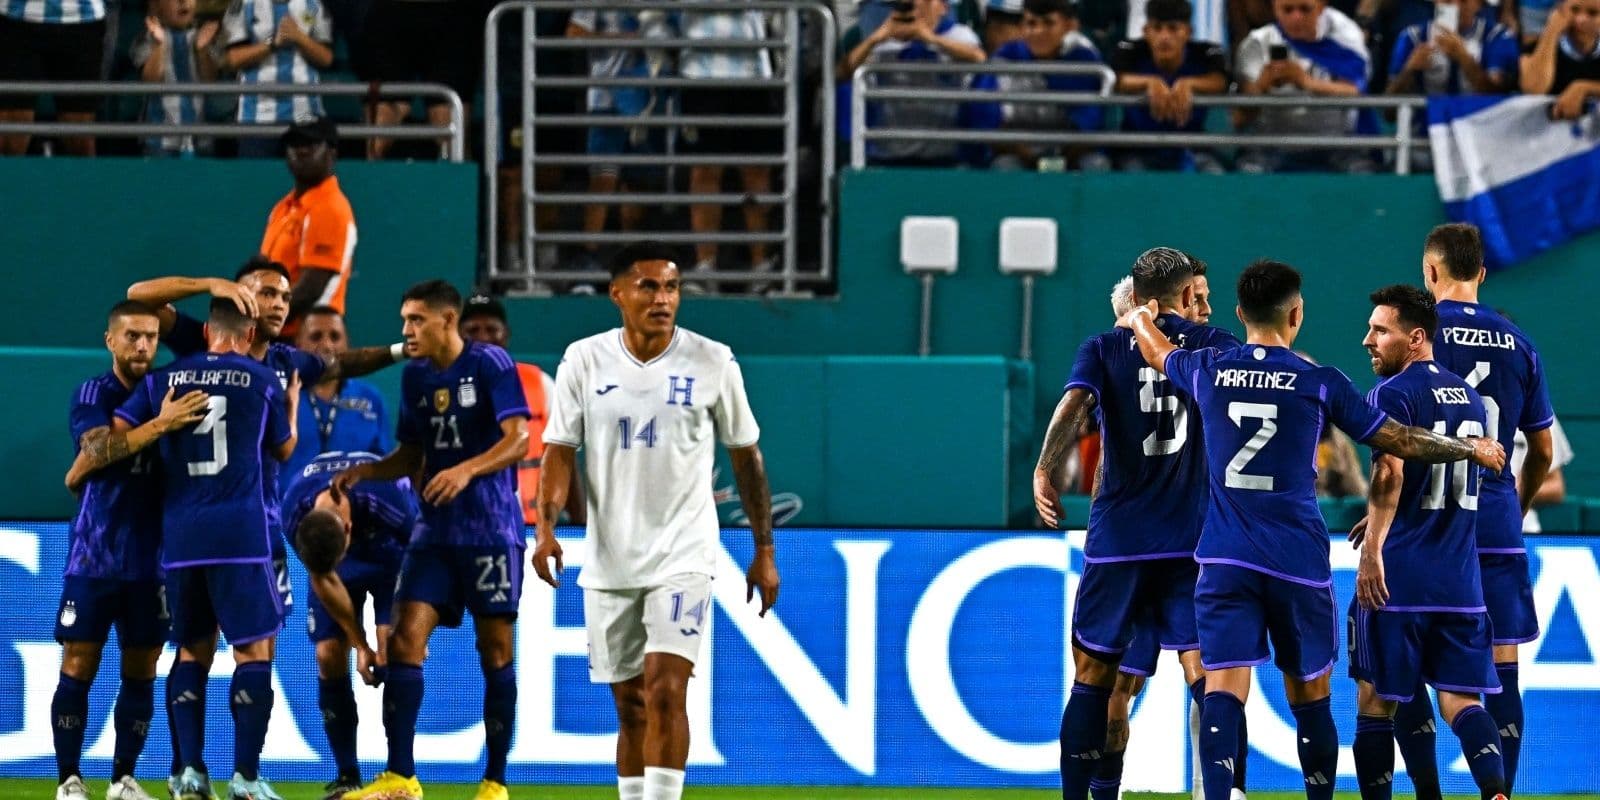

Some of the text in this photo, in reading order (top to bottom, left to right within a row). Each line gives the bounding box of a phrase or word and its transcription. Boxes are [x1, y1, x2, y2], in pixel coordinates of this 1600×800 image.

[1442, 326, 1516, 351] PEZZELLA
[167, 368, 252, 389] TAGLIAFICO
[665, 375, 696, 407] H
[1214, 368, 1298, 391] MARTINEZ
[1431, 386, 1471, 405] MESSI
[1138, 366, 1188, 457] 5
[187, 394, 228, 477] 3
[430, 415, 463, 450] 21
[617, 414, 658, 450] 14
[1225, 401, 1278, 491] 2
[1420, 419, 1485, 511] 10
[475, 554, 511, 591] 21
[671, 591, 706, 627] 14
